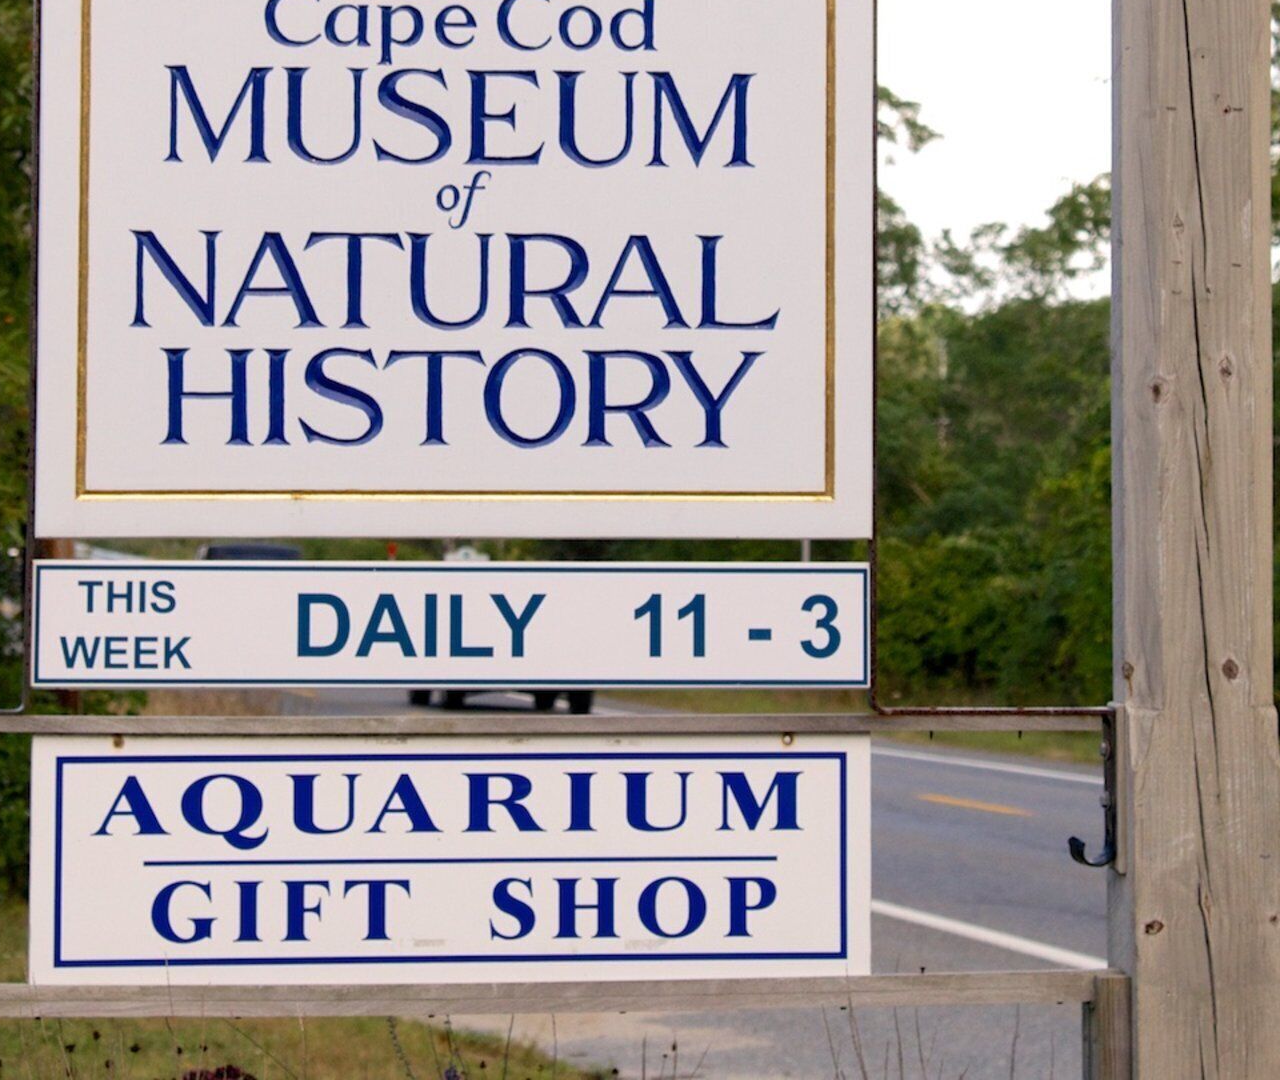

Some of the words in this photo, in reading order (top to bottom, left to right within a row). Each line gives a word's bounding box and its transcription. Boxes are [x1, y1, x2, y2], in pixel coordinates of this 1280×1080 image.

[164, 64, 755, 168] MUSEUM
[436, 170, 492, 230] of
[130, 229, 780, 331] NATURAL
[160, 346, 765, 449] HISTORY
[78, 580, 176, 614] THIS
[297, 593, 547, 658] DAILY
[634, 593, 706, 658] 11
[800, 594, 842, 659] 3
[59, 636, 192, 669] WEEK
[93, 771, 802, 851] AQUARIUM
[150, 879, 411, 944] GIFT
[489, 876, 777, 941] SHOP
